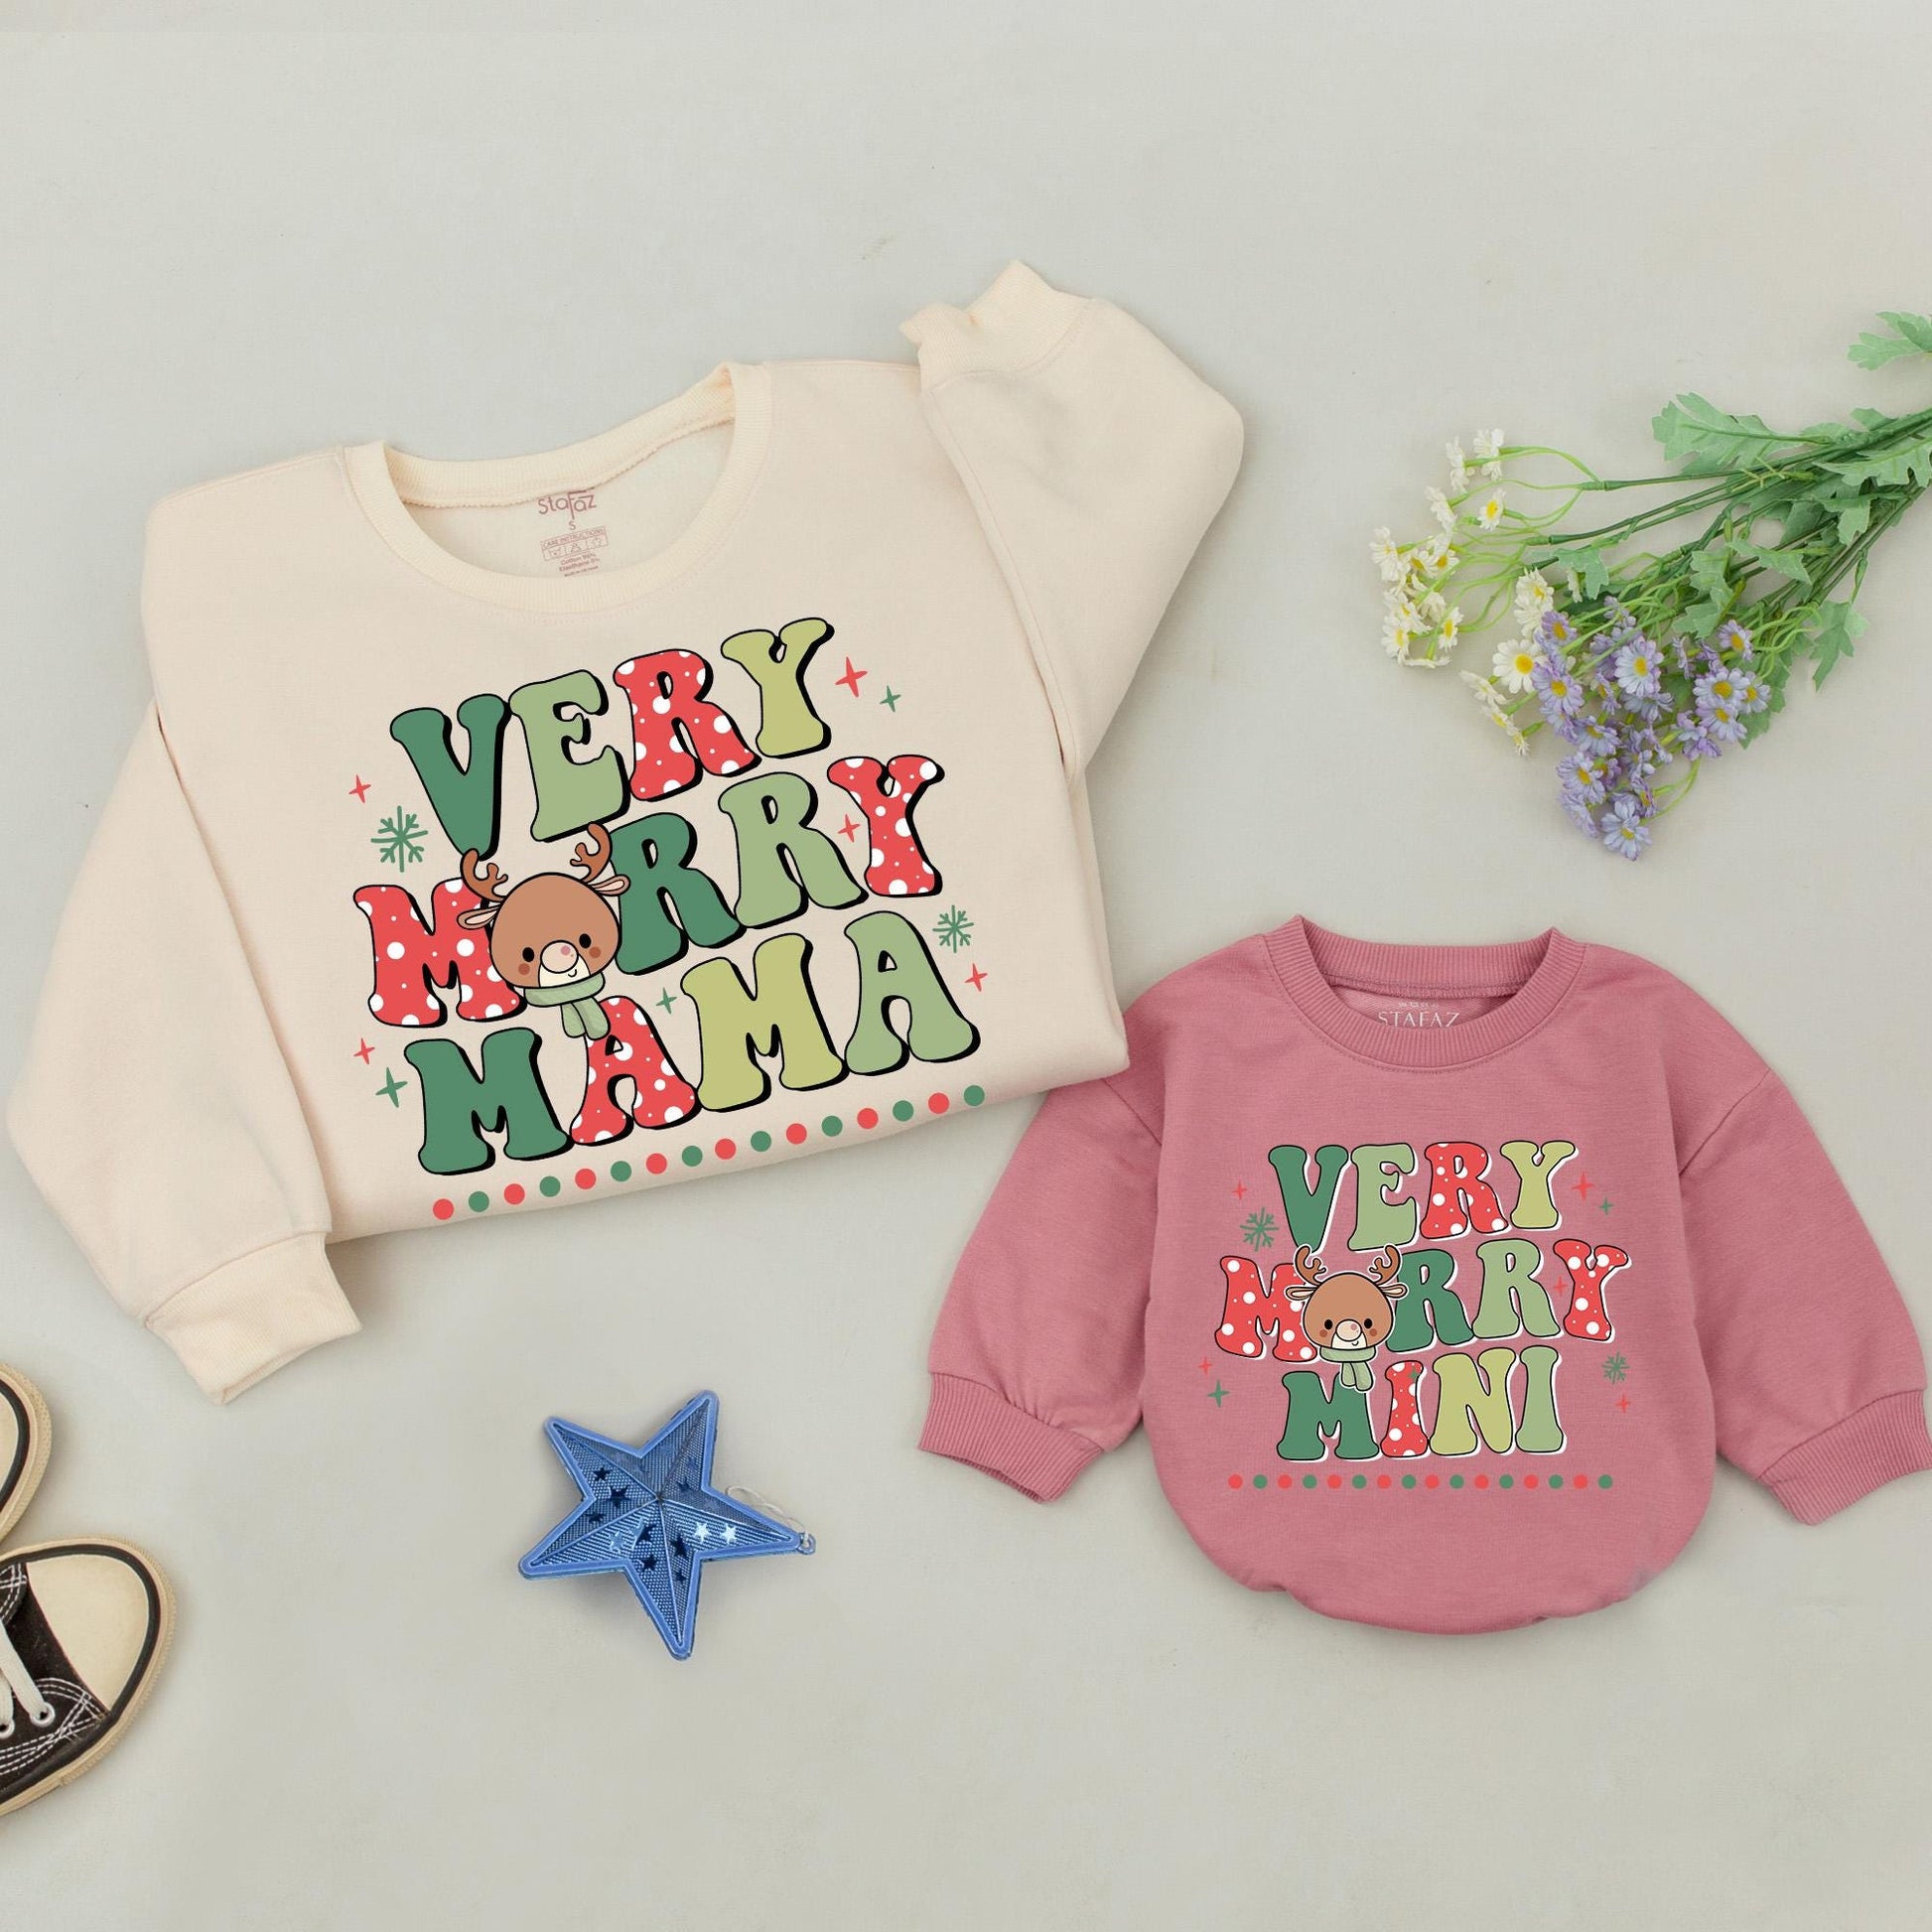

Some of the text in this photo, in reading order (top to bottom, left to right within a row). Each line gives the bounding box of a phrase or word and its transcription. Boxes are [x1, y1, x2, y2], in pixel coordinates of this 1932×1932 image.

[568, 520, 576, 530] S
[390, 617, 835, 862] VERY
[353, 755, 944, 1028] MRRY
[404, 910, 981, 1175] MAMA
[1377, 1010, 1459, 1028] STAFAZ
[1268, 1140, 1579, 1255] VERY
[1214, 1238, 1631, 1363] MRRY
[1276, 1344, 1567, 1462] MINI
